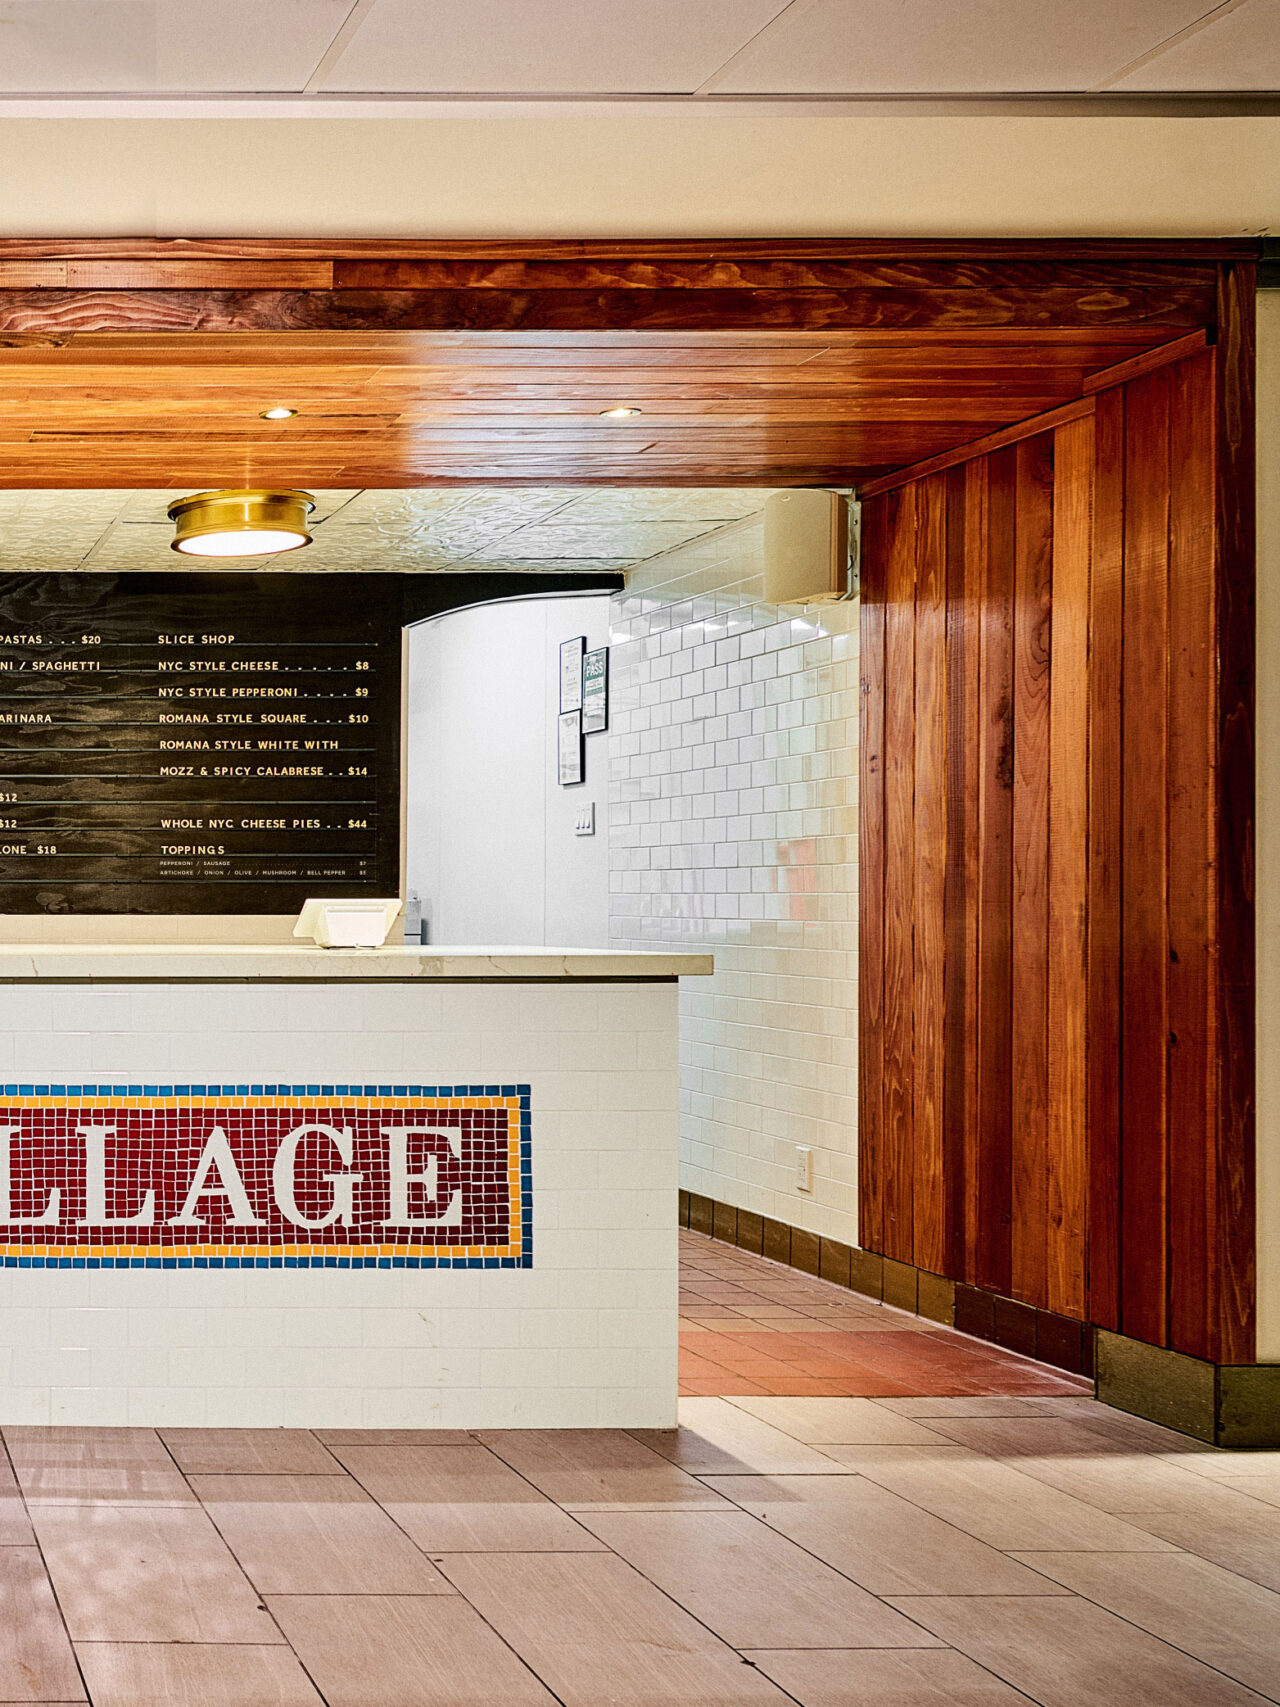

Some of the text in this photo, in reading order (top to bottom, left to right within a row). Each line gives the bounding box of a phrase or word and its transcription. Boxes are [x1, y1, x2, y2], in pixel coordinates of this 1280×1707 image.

[81, 635, 101, 644] $20
[158, 635, 234, 644] SLICE SHOP
[31, 662, 99, 671] SPAGHETTI
[158, 661, 370, 671] NYC STYLE CHEESE $8
[158, 688, 369, 696] NYC STYLE PEPPERONI $9
[159, 714, 369, 723] ROMANA STYLE SQUARE $10
[159, 741, 338, 749] ROMANA STYLE WHITE WITH
[159, 767, 193, 775] MOZZ
[213, 767, 250, 775] SPICY
[256, 767, 323, 775] CALABRESE
[348, 767, 368, 775] $14
[160, 820, 367, 828] WHOLE NYC CHEESE PIES $44
[37, 845, 57, 854] $18
[160, 846, 224, 854] TOPPINGS
